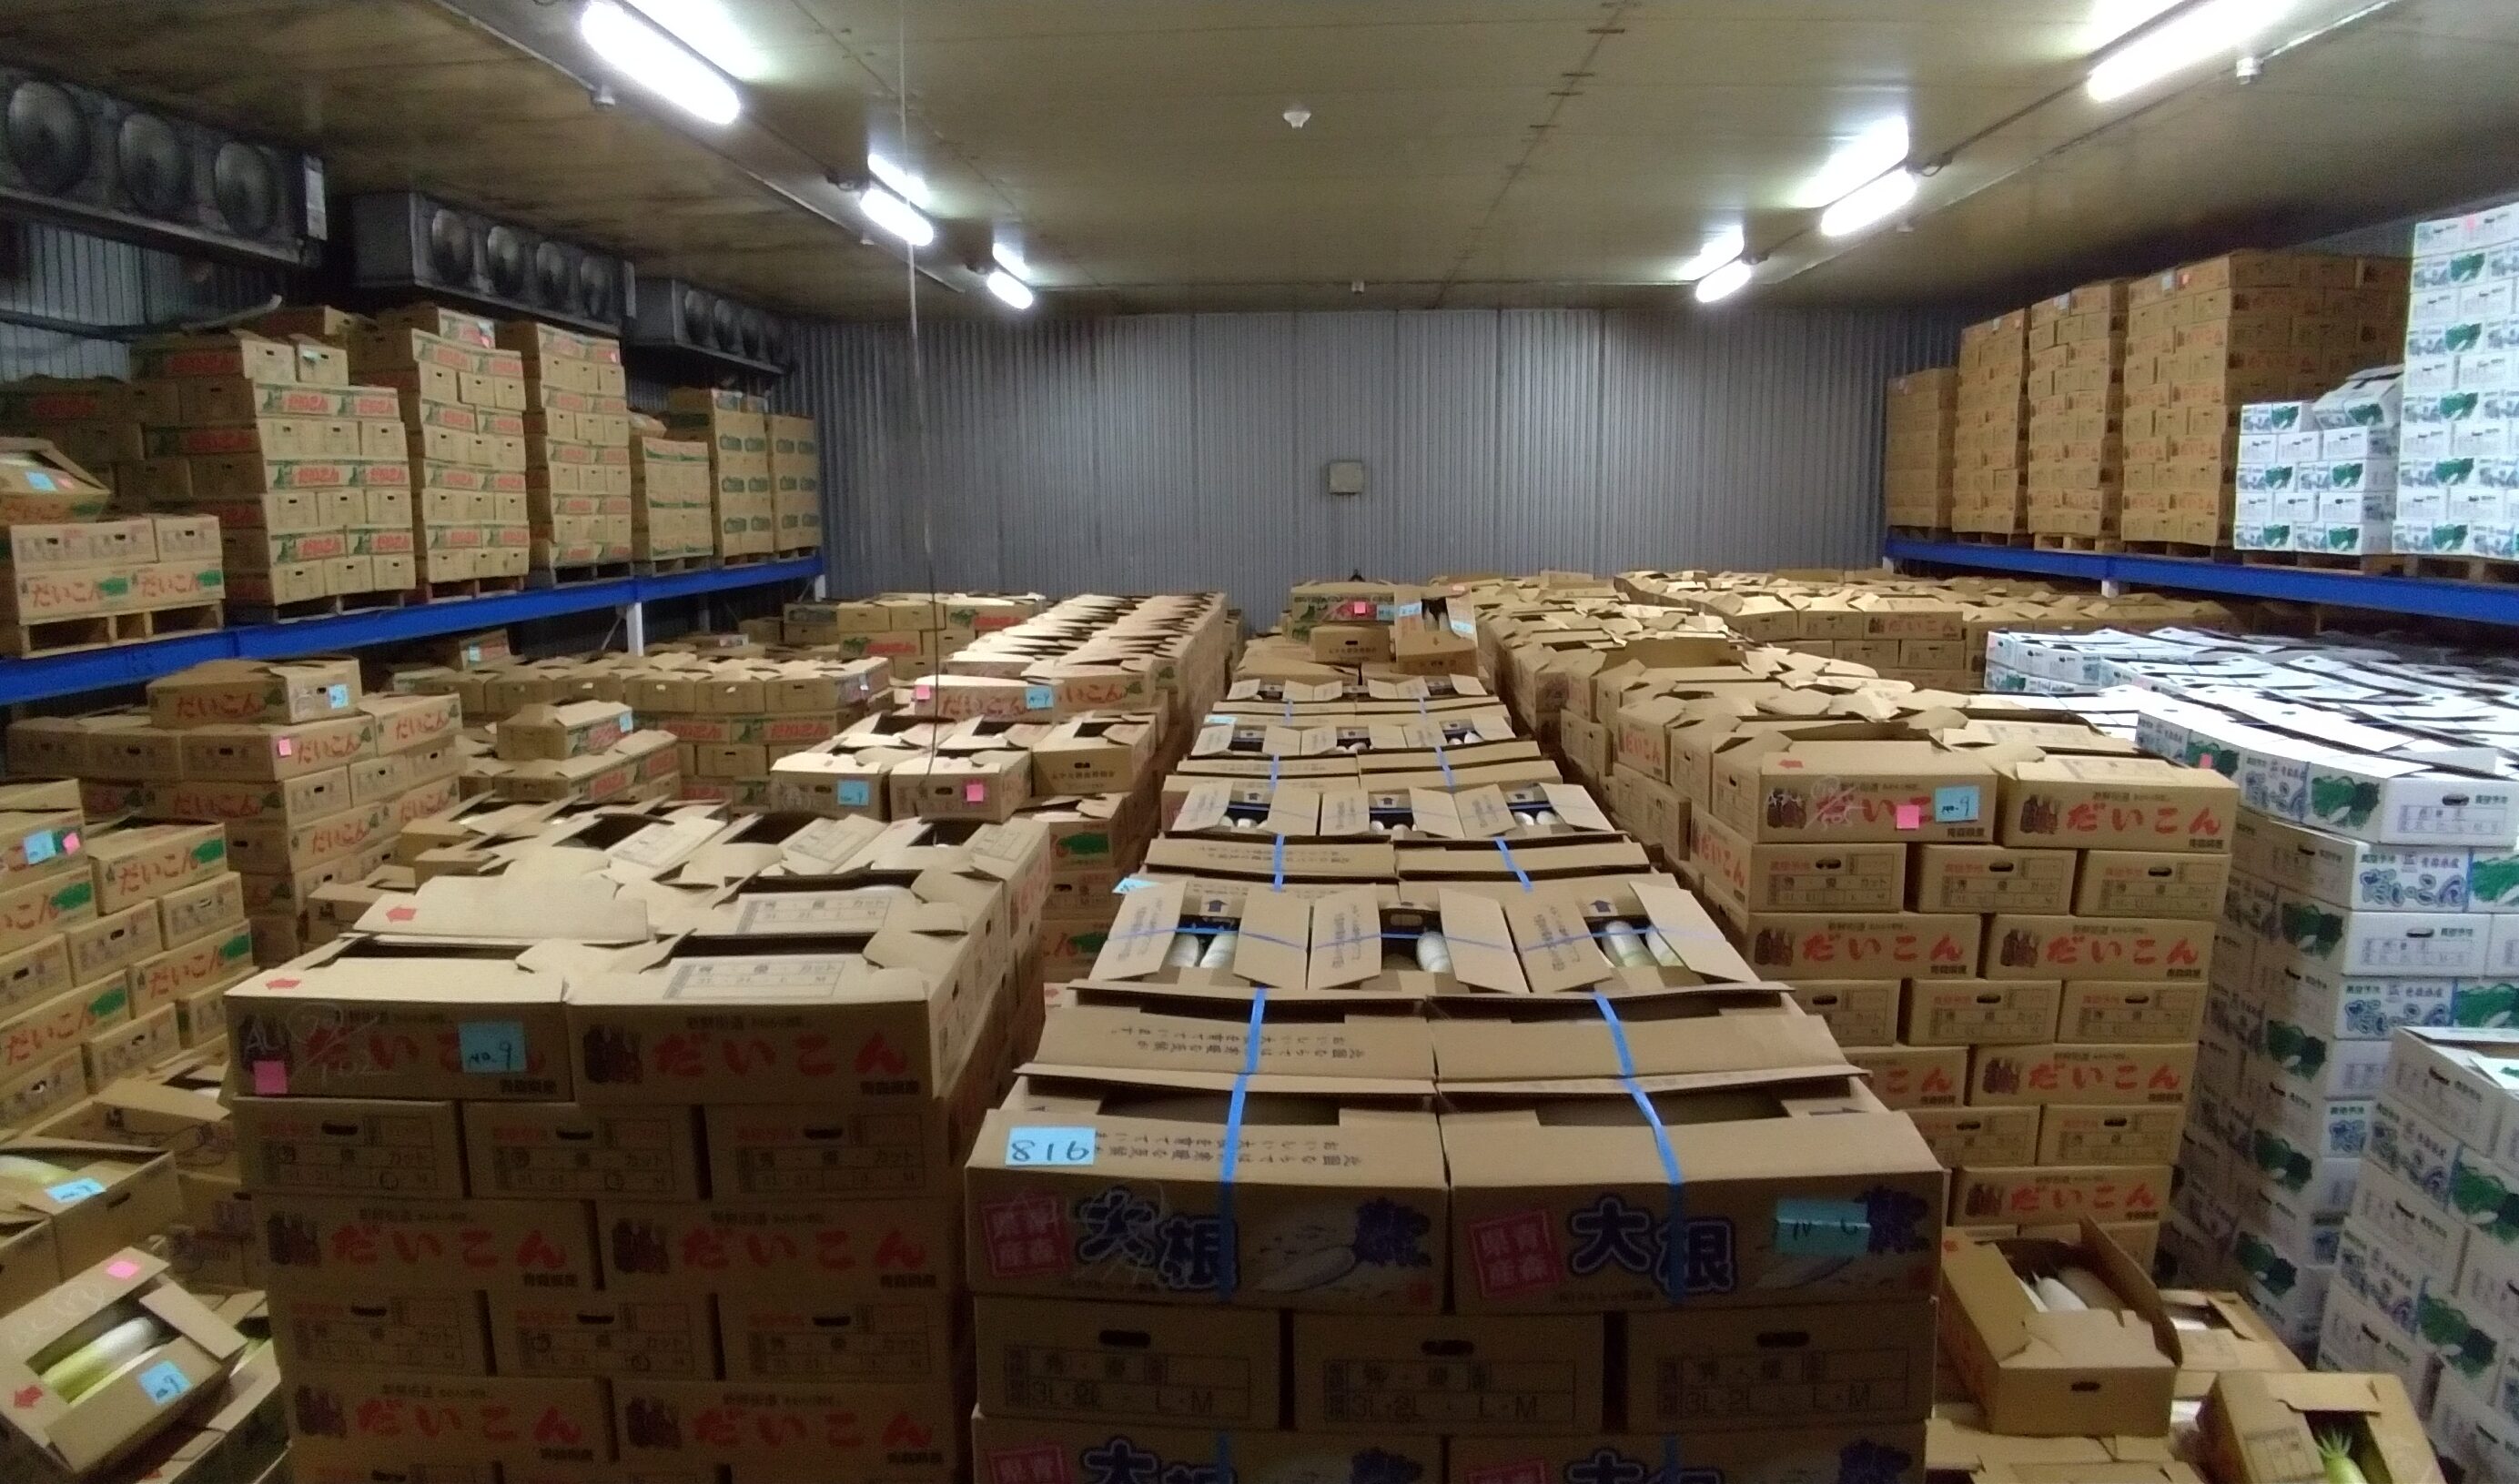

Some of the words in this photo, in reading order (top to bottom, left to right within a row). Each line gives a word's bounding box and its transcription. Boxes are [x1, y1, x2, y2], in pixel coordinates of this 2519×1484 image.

[2067, 803, 2221, 835] だいこん
[1803, 934, 1965, 963] だいこん
[2047, 936, 2200, 966] だいこん
[653, 1030, 910, 1077] だいこん
[2028, 1063, 2180, 1090] だいこん
[1010, 1140, 1090, 1161] 816
[2010, 1183, 2157, 1211] だいこん
[331, 1225, 566, 1269] だいこん
[682, 1227, 926, 1270] だいこん
[1076, 1186, 1239, 1291] 大根
[1570, 1193, 1737, 1294] 大根
[357, 1398, 582, 1444] だいこん
[692, 1408, 933, 1449] だいこん
